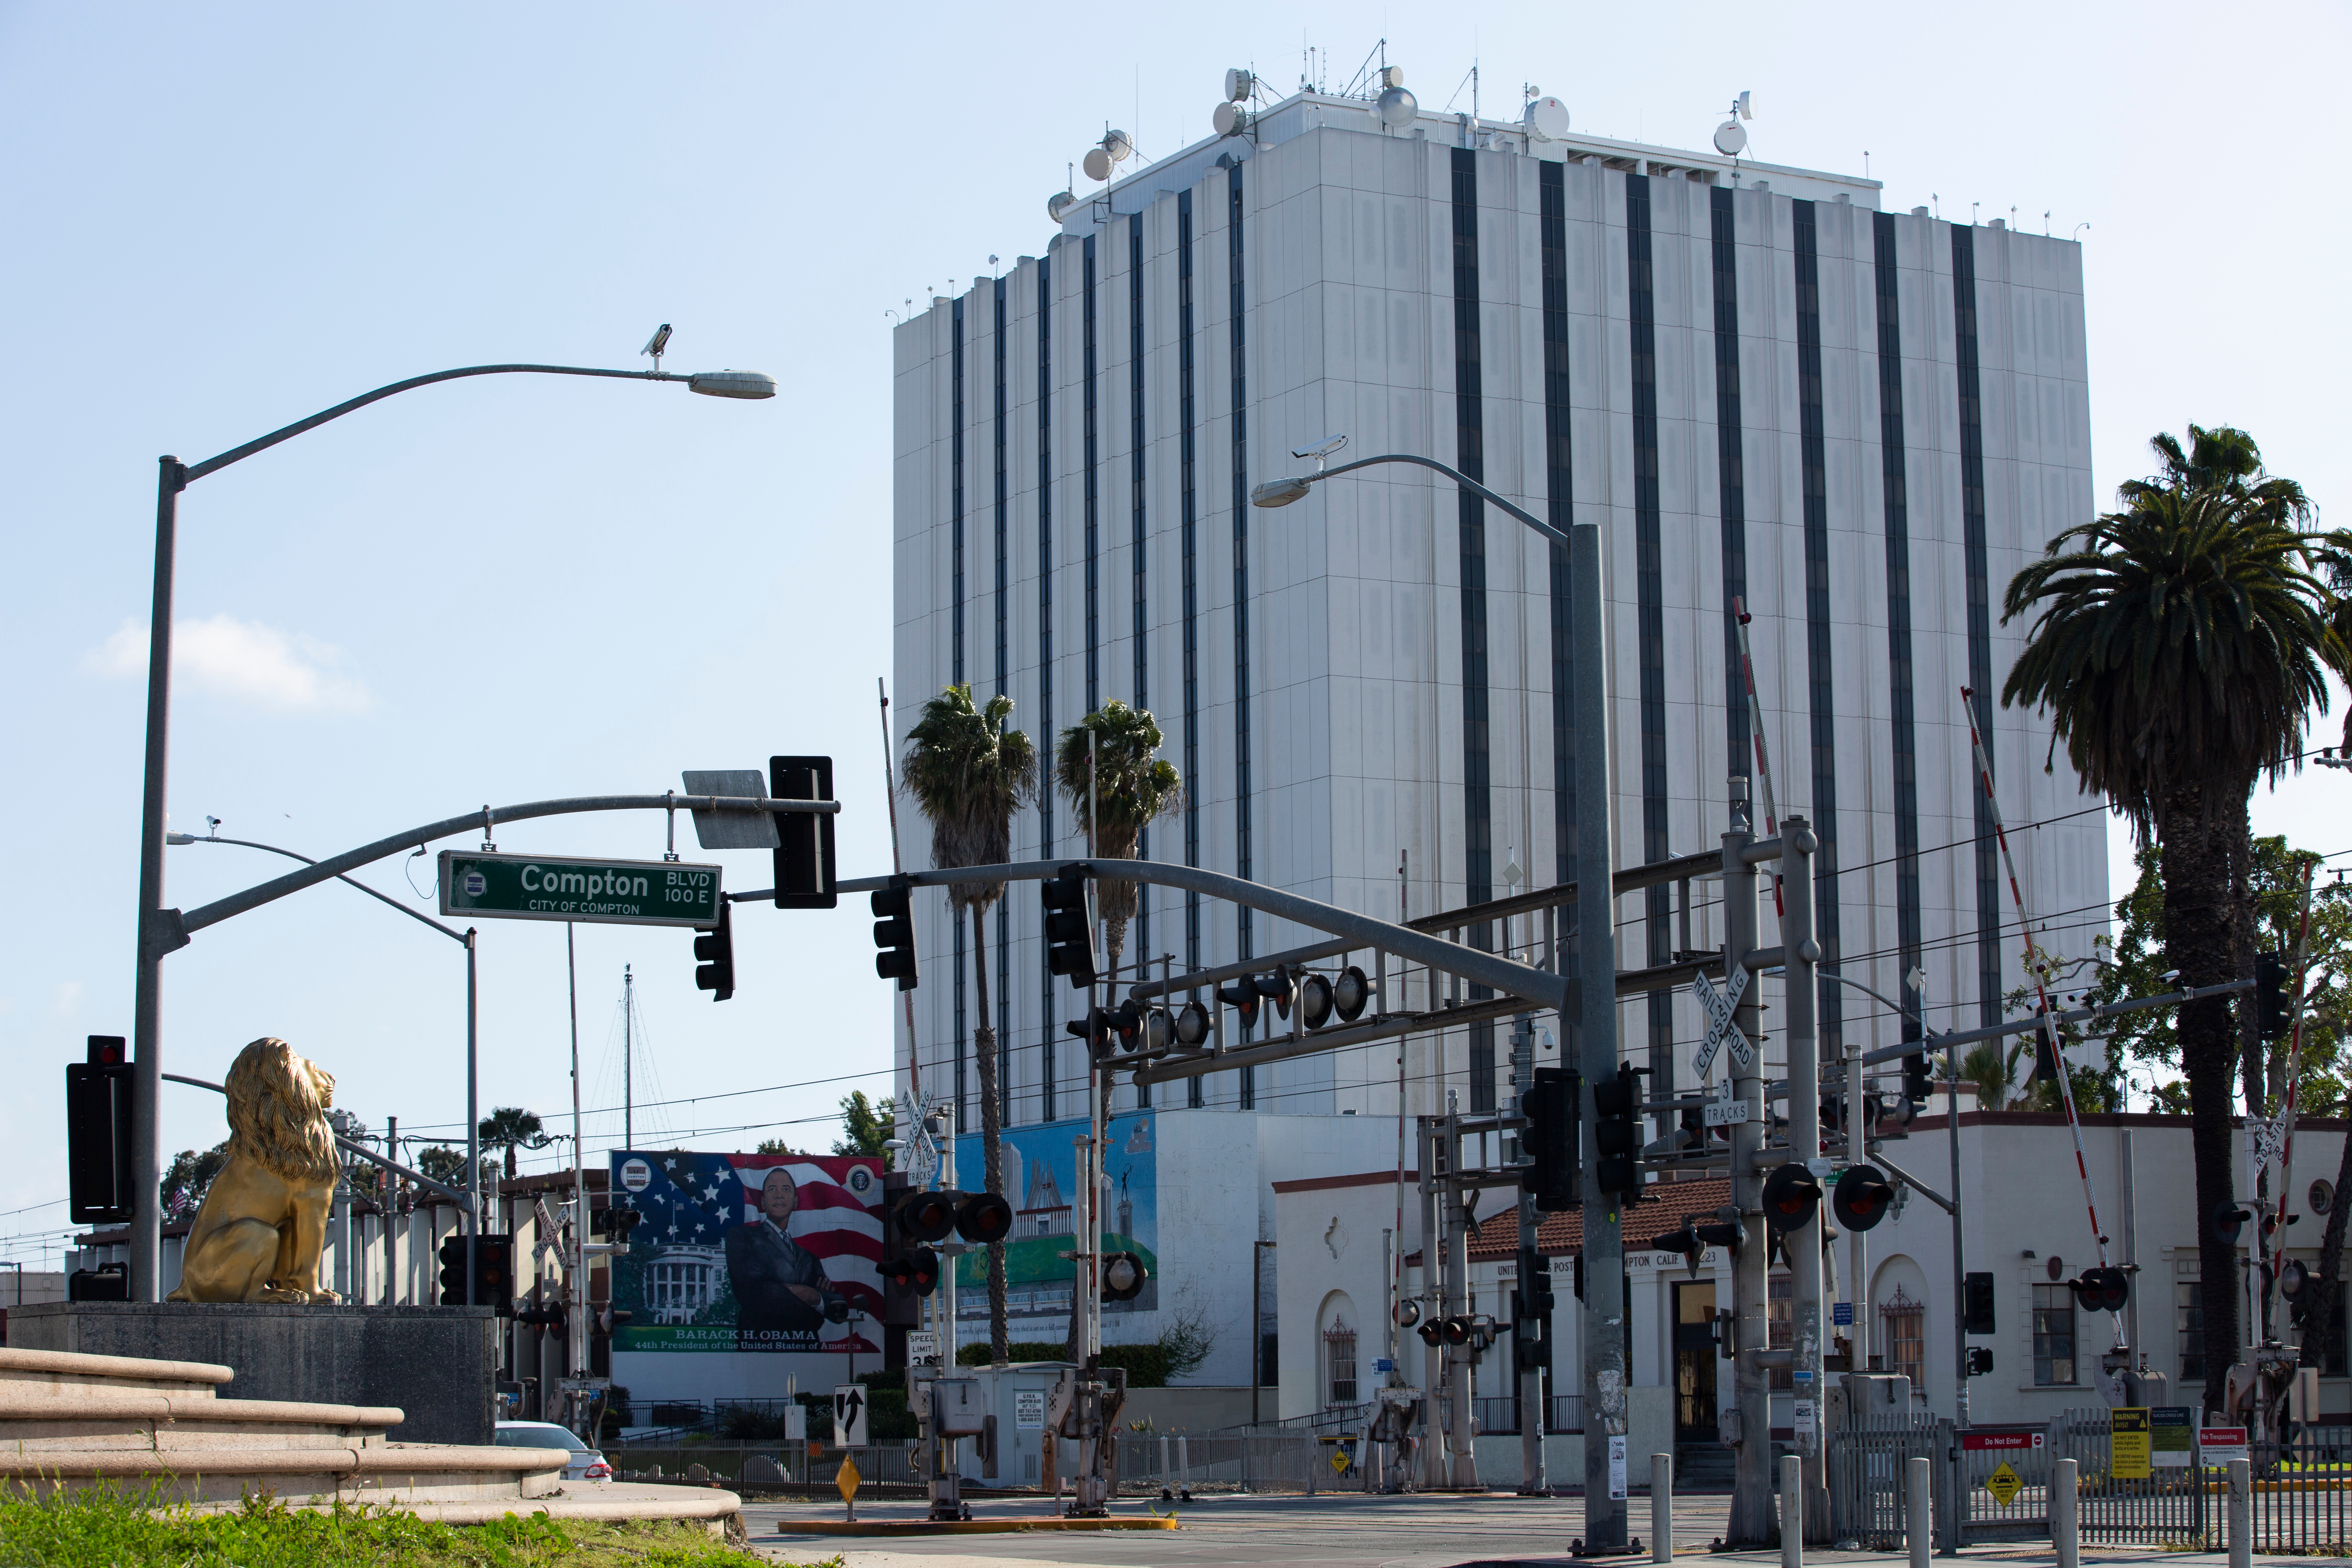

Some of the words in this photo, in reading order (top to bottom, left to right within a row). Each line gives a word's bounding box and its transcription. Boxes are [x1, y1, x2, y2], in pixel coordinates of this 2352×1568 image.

[521, 865, 648, 900] Compton
[667, 872, 709, 886] BLVD
[529, 900, 557, 911] CITY
[561, 901, 577, 911] OF
[580, 902, 639, 915] COMPTON
[665, 889, 693, 902] 100
[699, 890, 708, 903] E
[1694, 976, 1715, 1015] RAIL
[1726, 1025, 1750, 1065] ROAD
[1697, 974, 1744, 1068] CROSSING
[1723, 1083, 1728, 1099] 3
[1707, 1105, 1745, 1121] TRACKS
[903, 1091, 914, 1122] RAIL
[920, 1130, 932, 1161] ROAD
[903, 1091, 929, 1161] CROSSING
[2256, 1111, 2287, 1174] ROSSING
[917, 1154, 921, 1166] 3
[909, 1171, 931, 1182] TRACKS
[535, 1211, 566, 1258] CROSSING
[536, 1203, 549, 1229] RAIL
[553, 1240, 566, 1266] ROAD
[1498, 1265, 1517, 1275] UNITE
[1554, 1261, 1574, 1272] POST
[1657, 1254, 1679, 1265] CALIF.
[1700, 1252, 1715, 1263] 223
[675, 1330, 739, 1339] BARACK
[743, 1330, 757, 1339] H.
[760, 1330, 816, 1340] OBAMA
